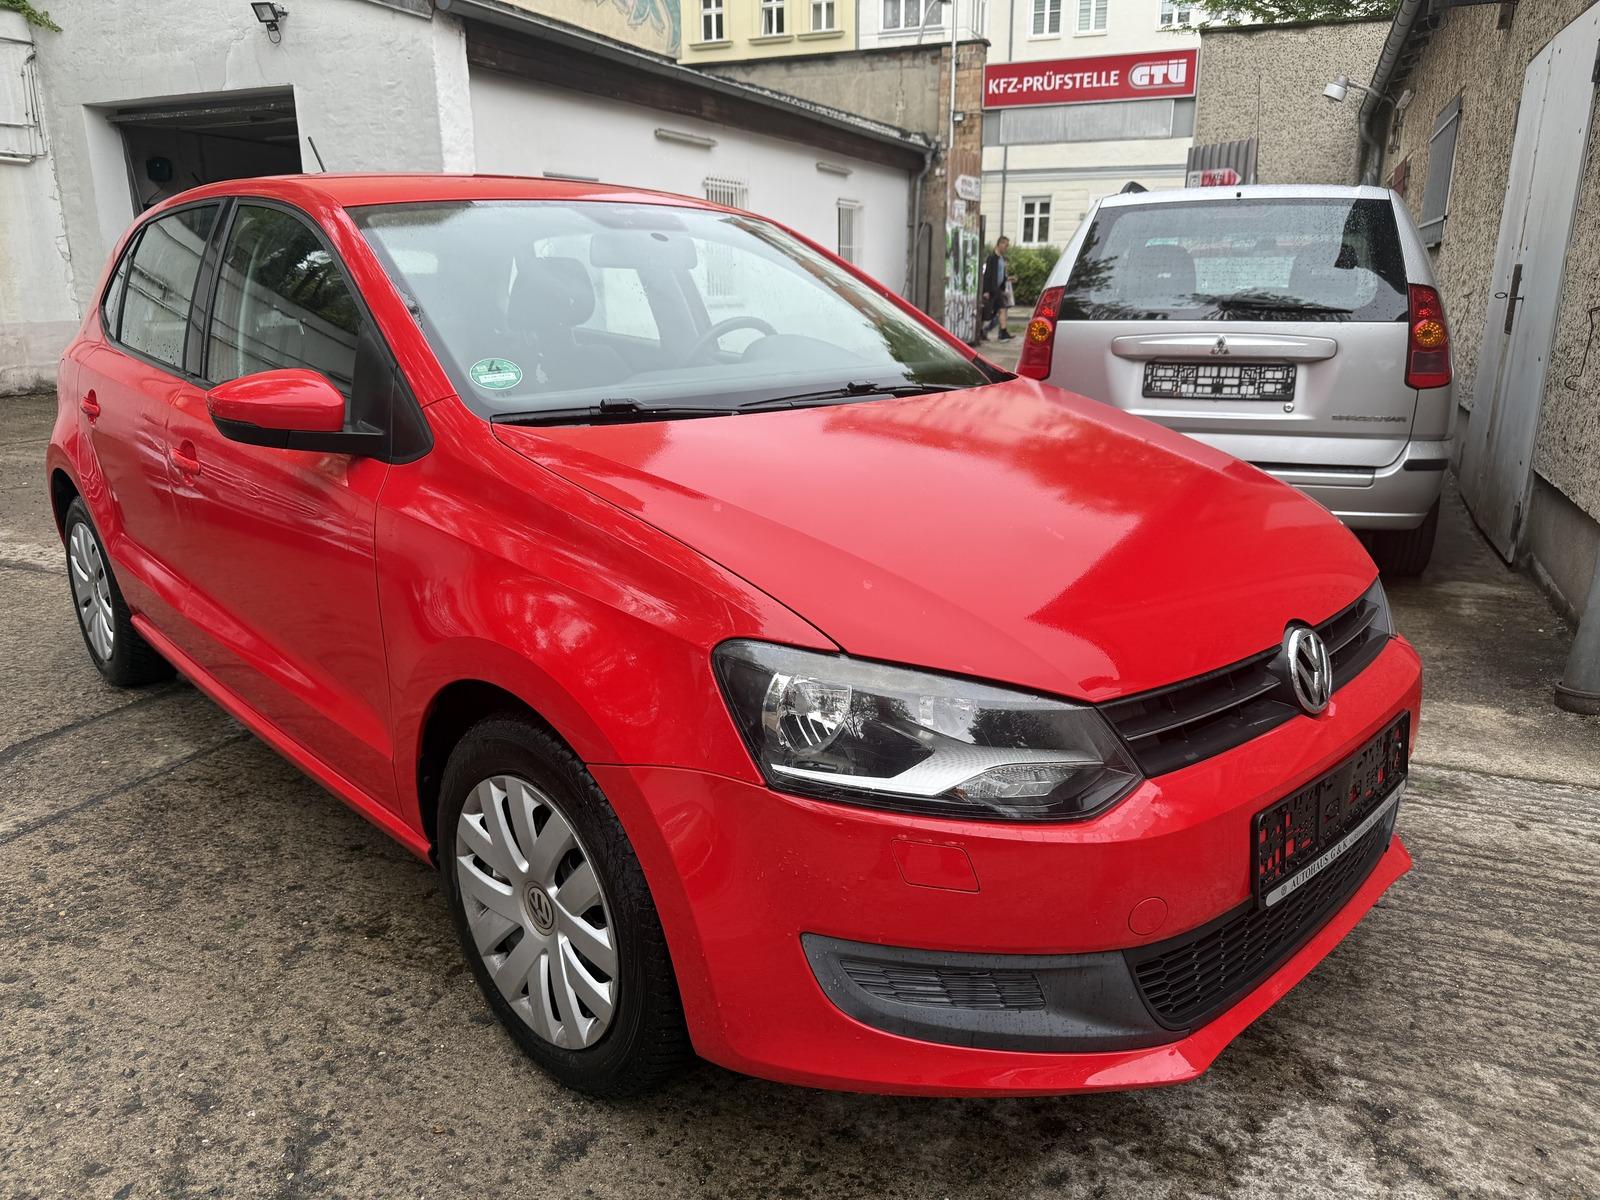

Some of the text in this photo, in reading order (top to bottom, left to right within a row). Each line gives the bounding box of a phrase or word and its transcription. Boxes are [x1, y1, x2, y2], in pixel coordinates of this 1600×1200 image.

[988, 58, 1187, 94] KFZ-PRÜFSTELLE GTÜ
[1290, 854, 1329, 889] AUTOHAUS
